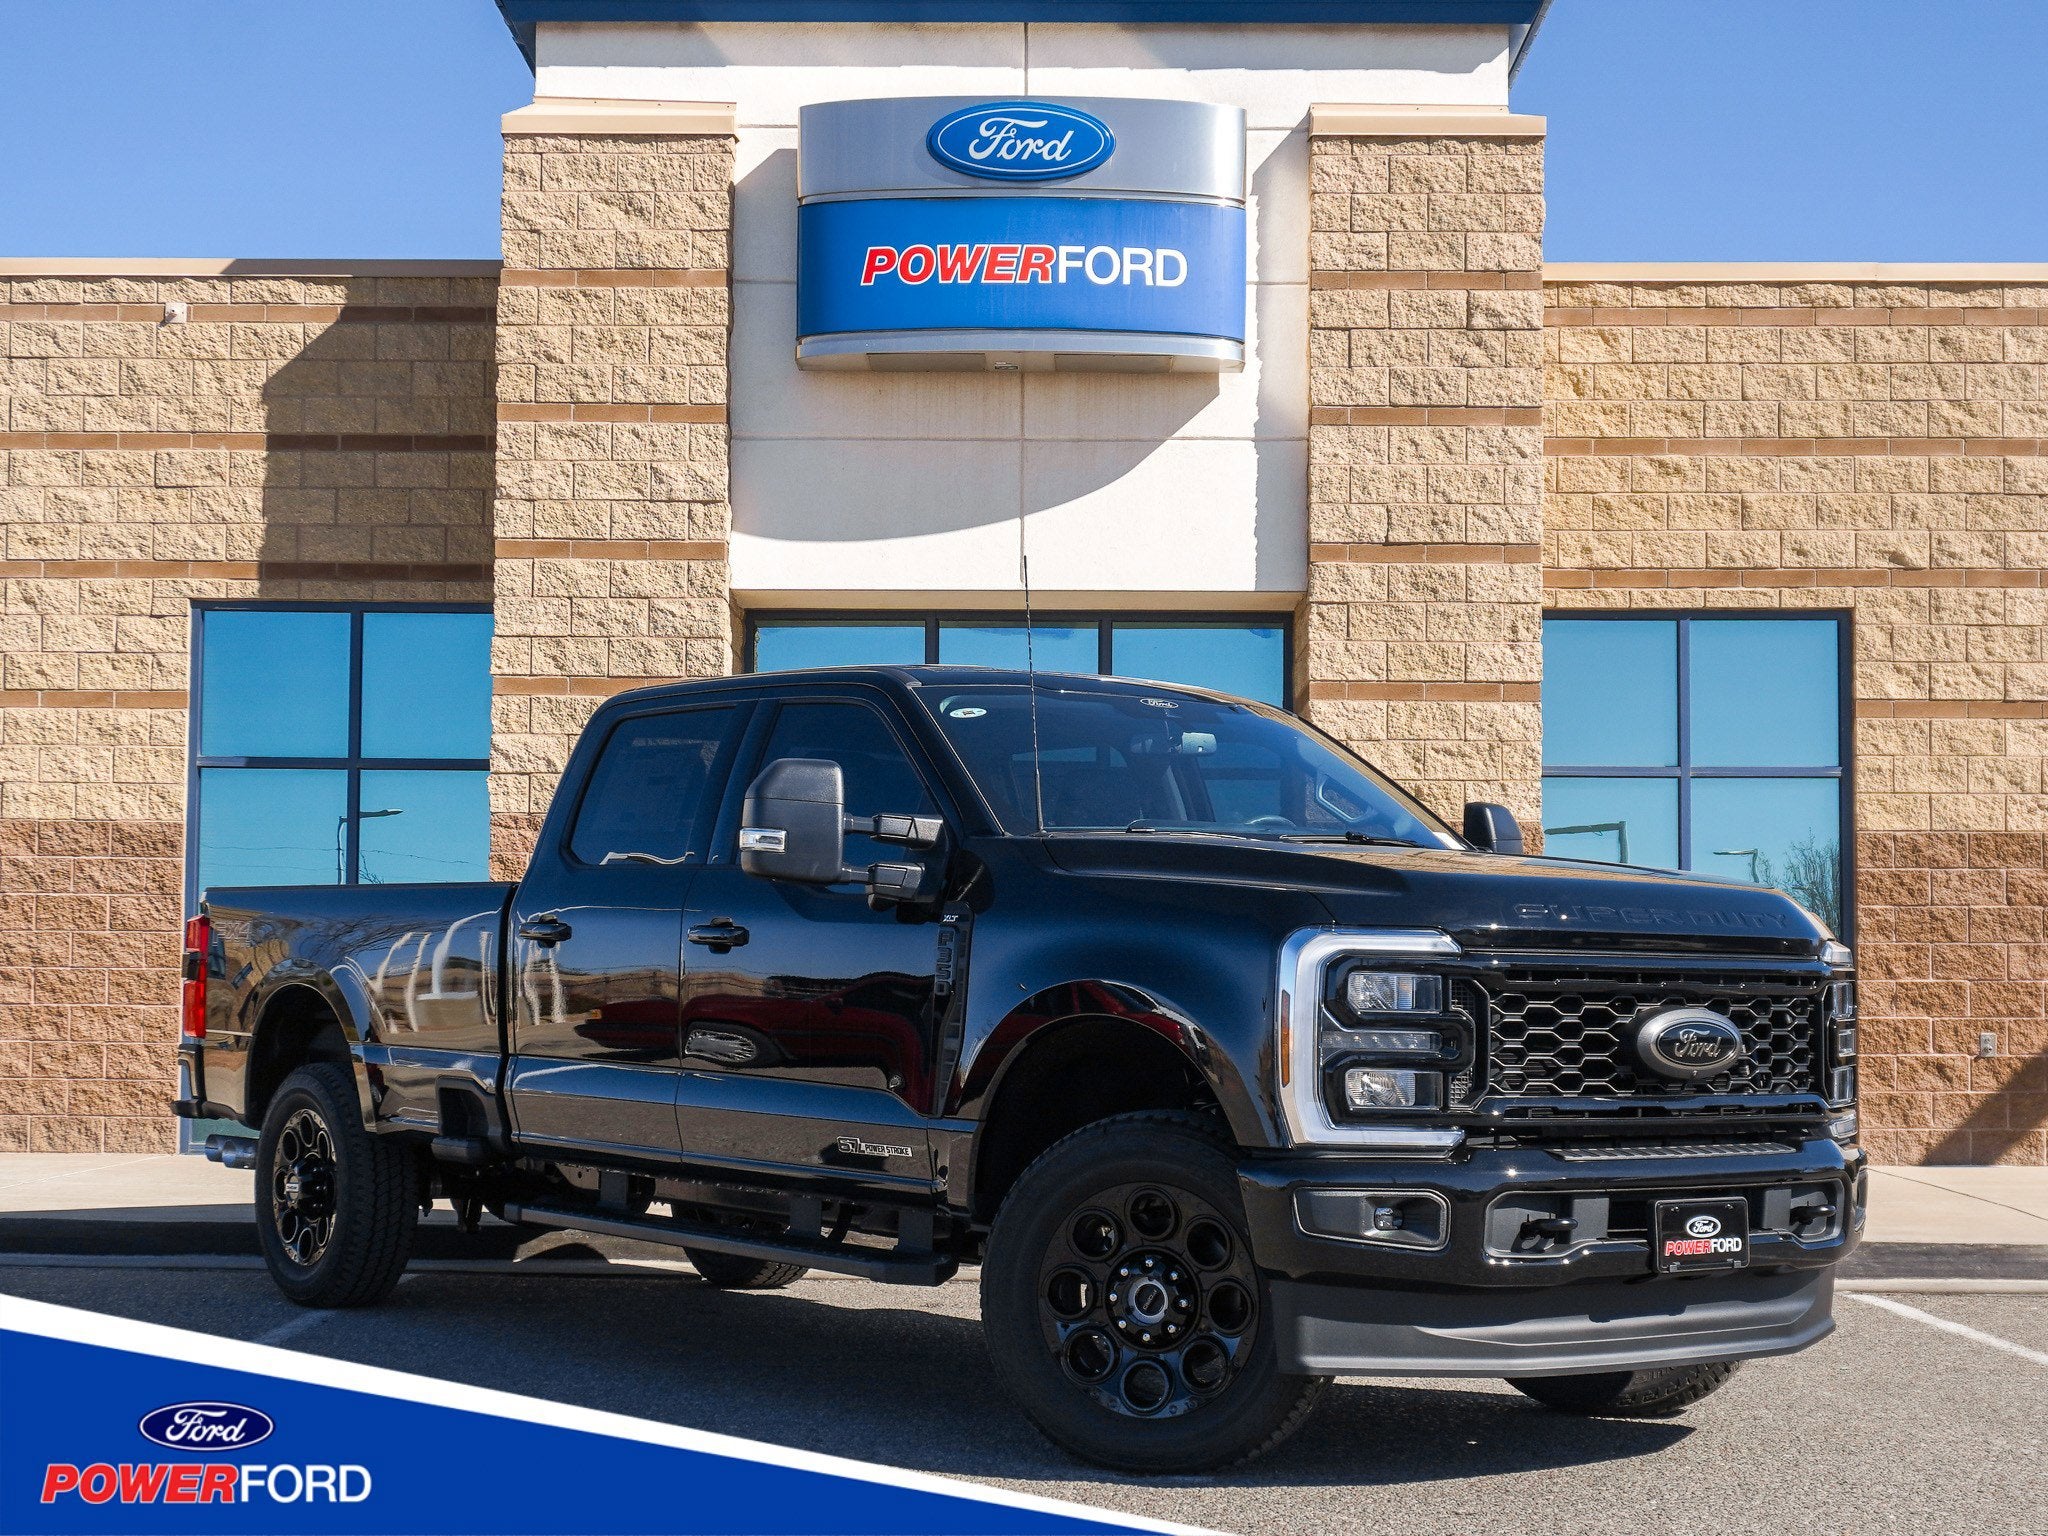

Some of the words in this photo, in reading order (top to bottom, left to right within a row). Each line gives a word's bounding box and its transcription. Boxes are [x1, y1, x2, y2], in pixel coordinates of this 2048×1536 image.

[967, 117, 1074, 161] Ford
[860, 244, 1188, 287] POWERFORD
[942, 914, 959, 922] XLT
[1673, 1027, 1723, 1059] Ford
[865, 1143, 886, 1153] POWER
[886, 1145, 910, 1156] STROKE
[1692, 1220, 1714, 1234] Ford
